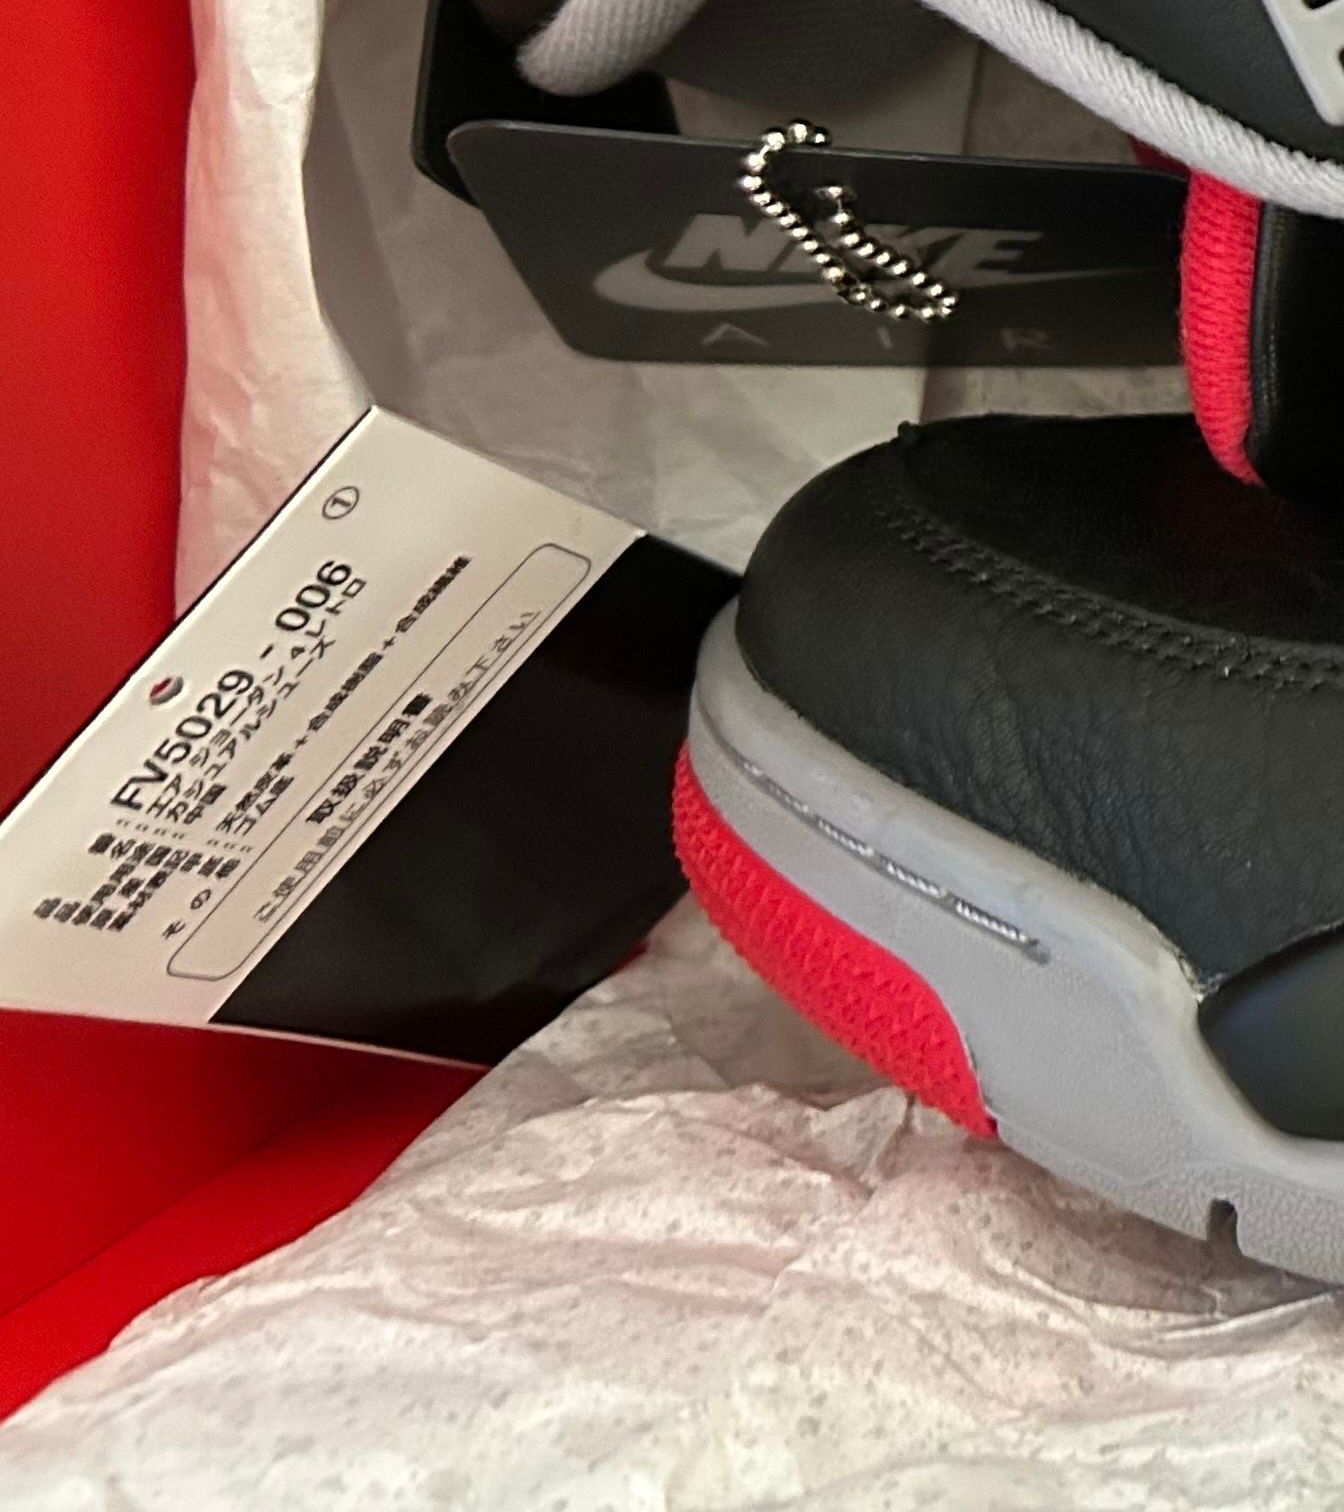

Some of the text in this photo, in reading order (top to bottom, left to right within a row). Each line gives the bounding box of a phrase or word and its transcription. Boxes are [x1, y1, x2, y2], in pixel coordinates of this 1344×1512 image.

[110, 670, 254, 811] FV5029
[275, 561, 352, 632] 006
[159, 635, 336, 823] カジュアルシューズ
